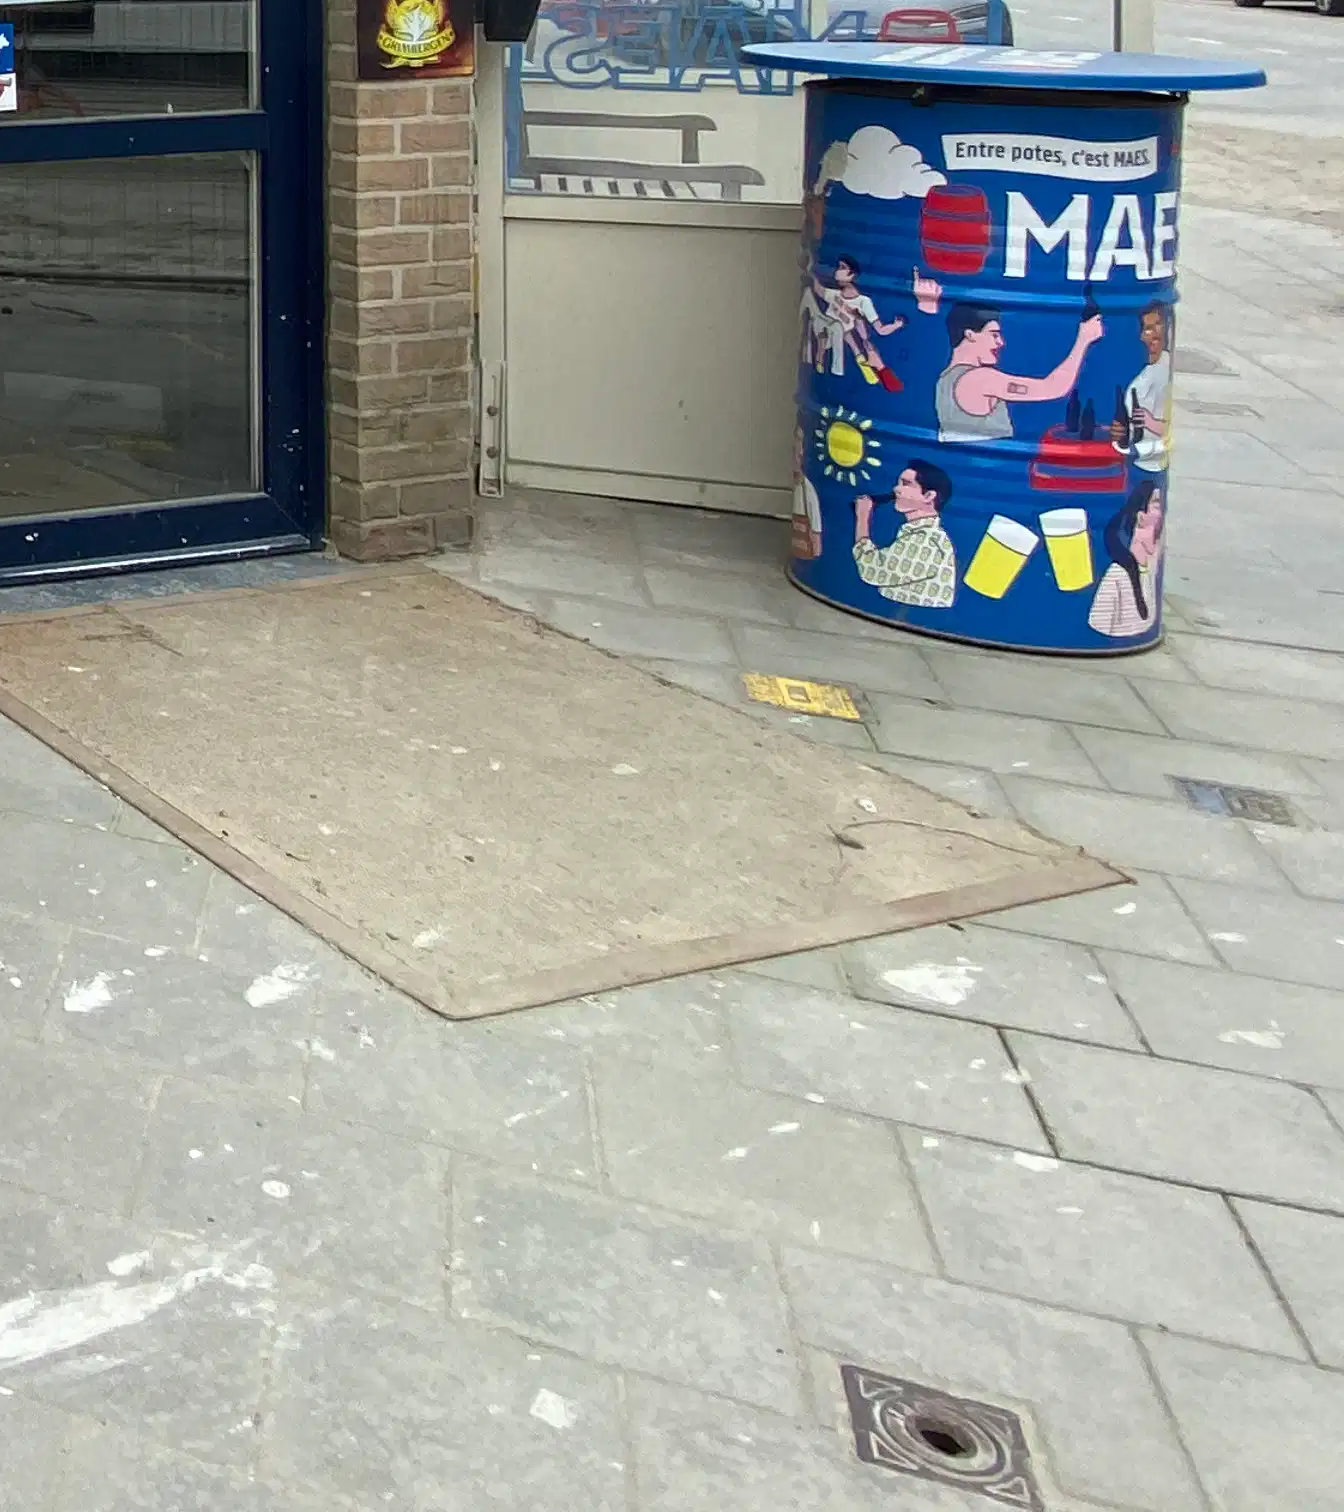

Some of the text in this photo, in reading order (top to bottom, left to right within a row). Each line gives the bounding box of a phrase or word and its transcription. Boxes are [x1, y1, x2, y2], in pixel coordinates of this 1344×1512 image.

[955, 142, 1005, 159] Entre
[1012, 143, 1067, 167] potes,
[1072, 149, 1110, 168] c'est
[1003, 191, 1180, 281] MAE
